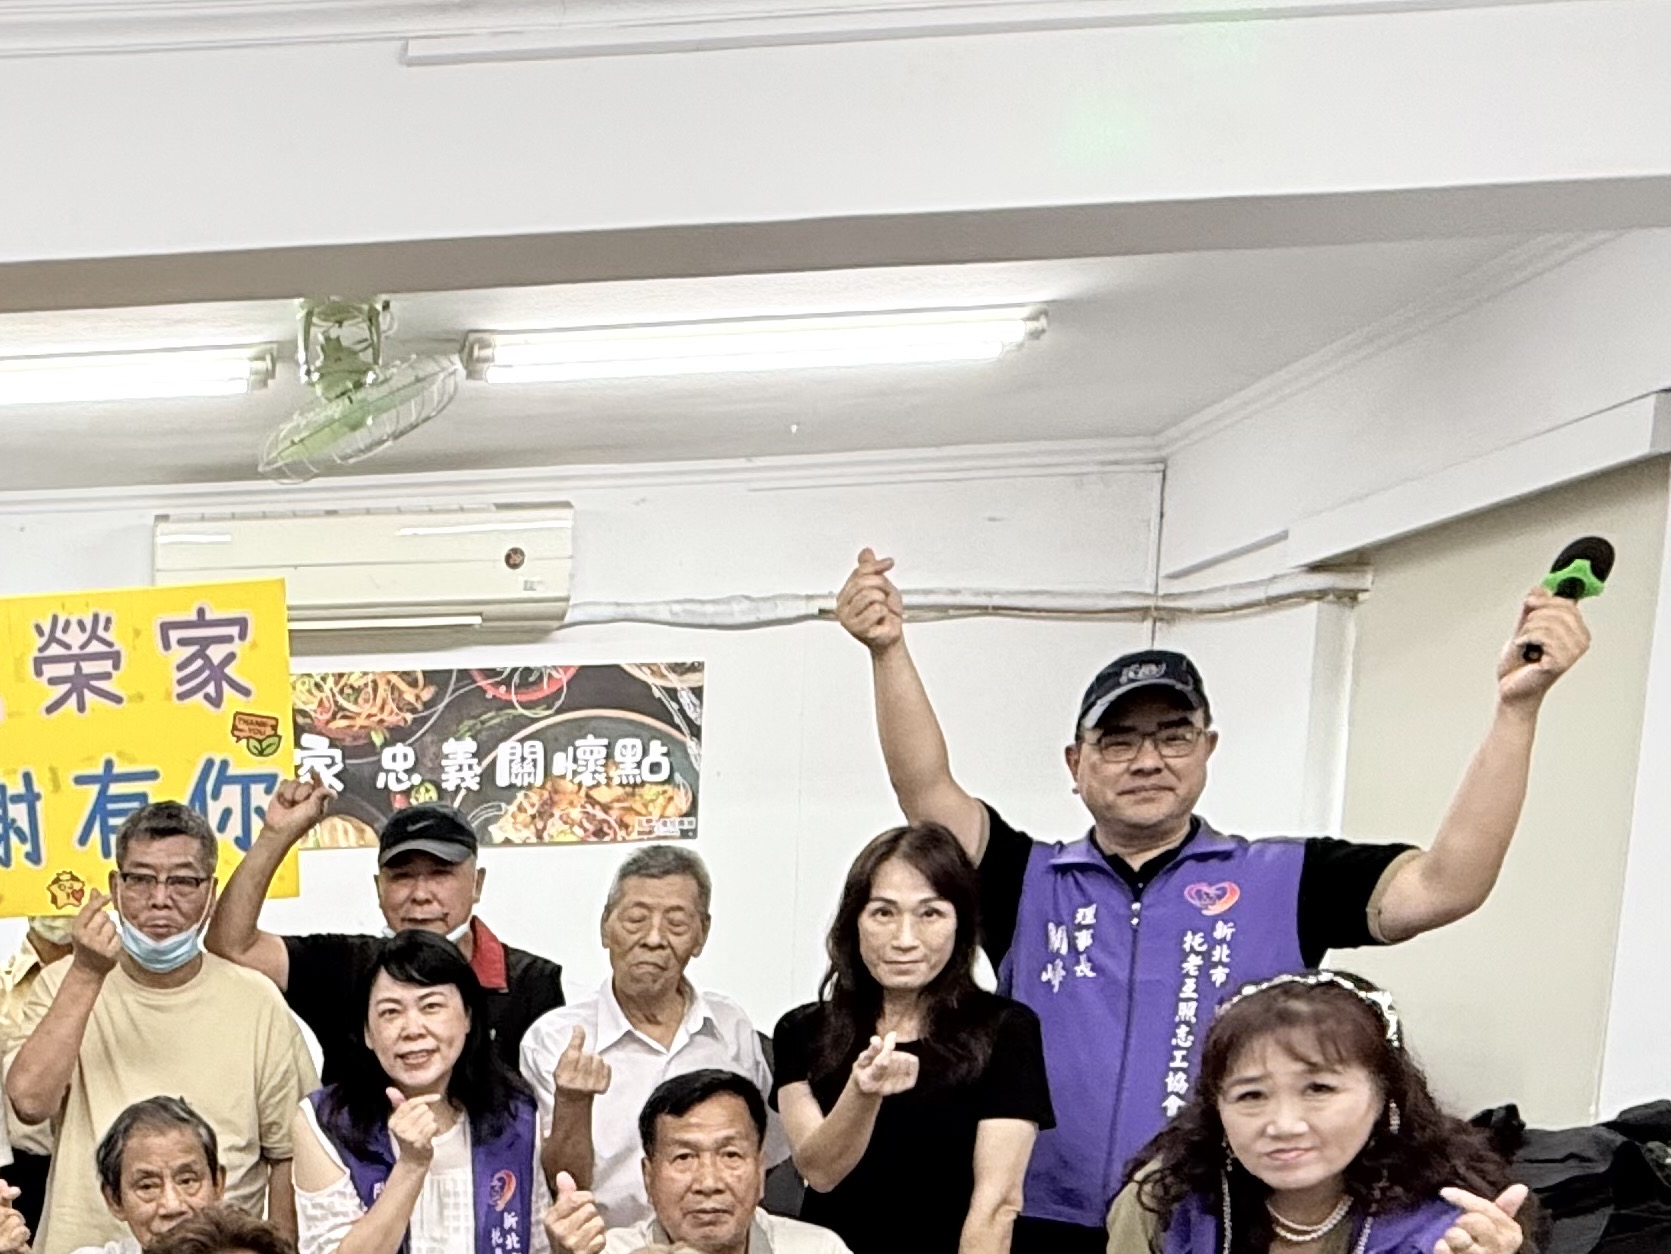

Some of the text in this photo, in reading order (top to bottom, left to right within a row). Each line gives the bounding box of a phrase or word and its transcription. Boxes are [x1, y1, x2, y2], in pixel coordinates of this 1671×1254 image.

[1074, 903, 1097, 978] 理事長
[1210, 920, 1236, 988] 新北市
[1162, 930, 1208, 1117] 托老互照志工協會
